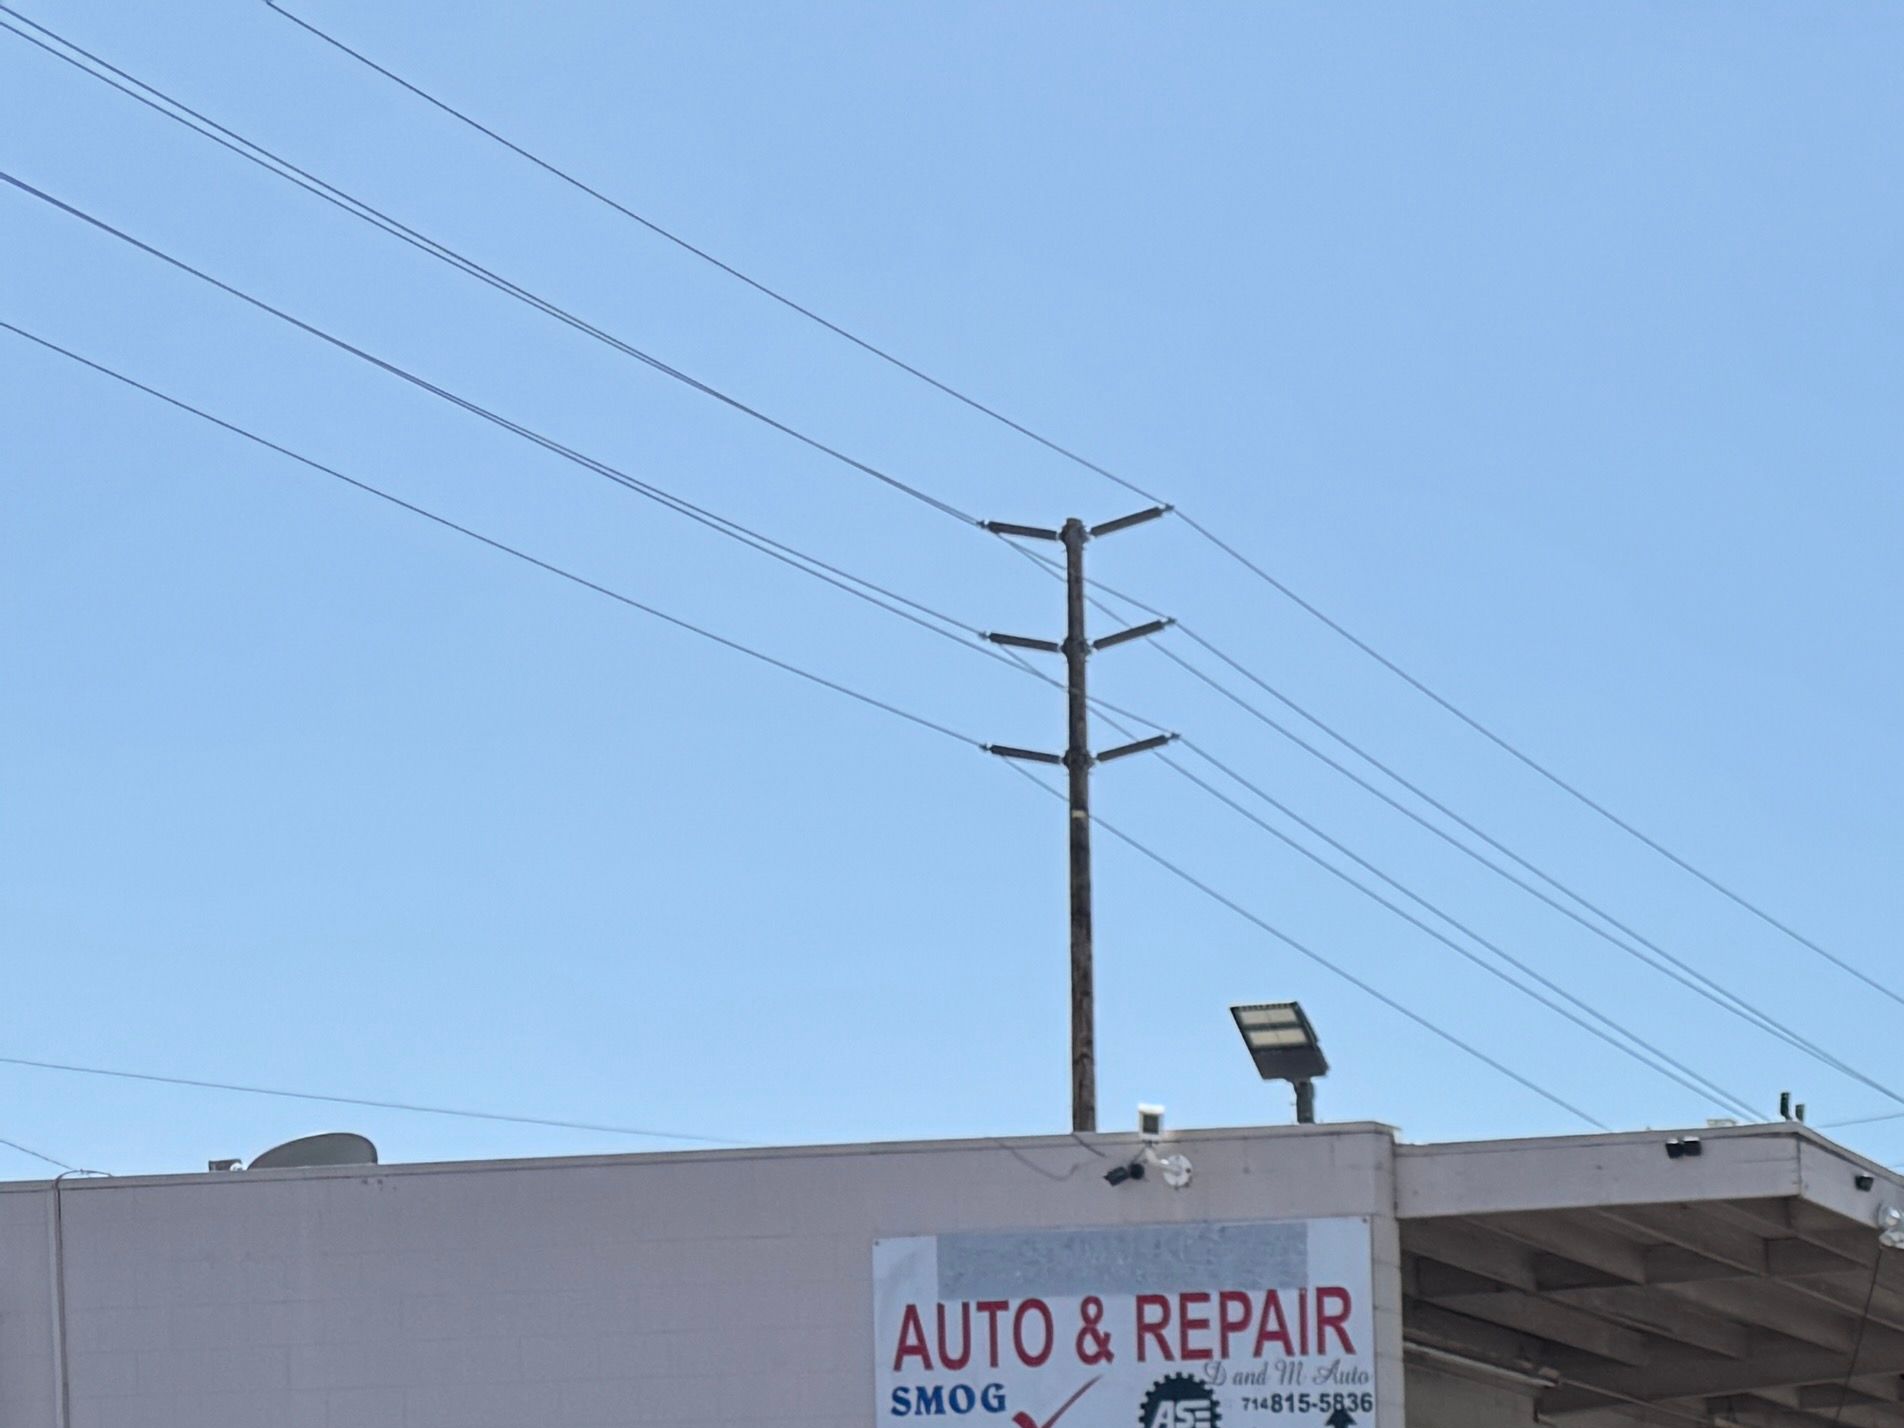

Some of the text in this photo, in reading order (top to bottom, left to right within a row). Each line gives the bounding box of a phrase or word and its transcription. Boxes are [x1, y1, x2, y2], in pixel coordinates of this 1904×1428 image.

[893, 1286, 1357, 1372] AUTO & REPAIR
[1204, 1358, 1370, 1386] D and M Auto
[891, 1382, 1007, 1417] SMOG
